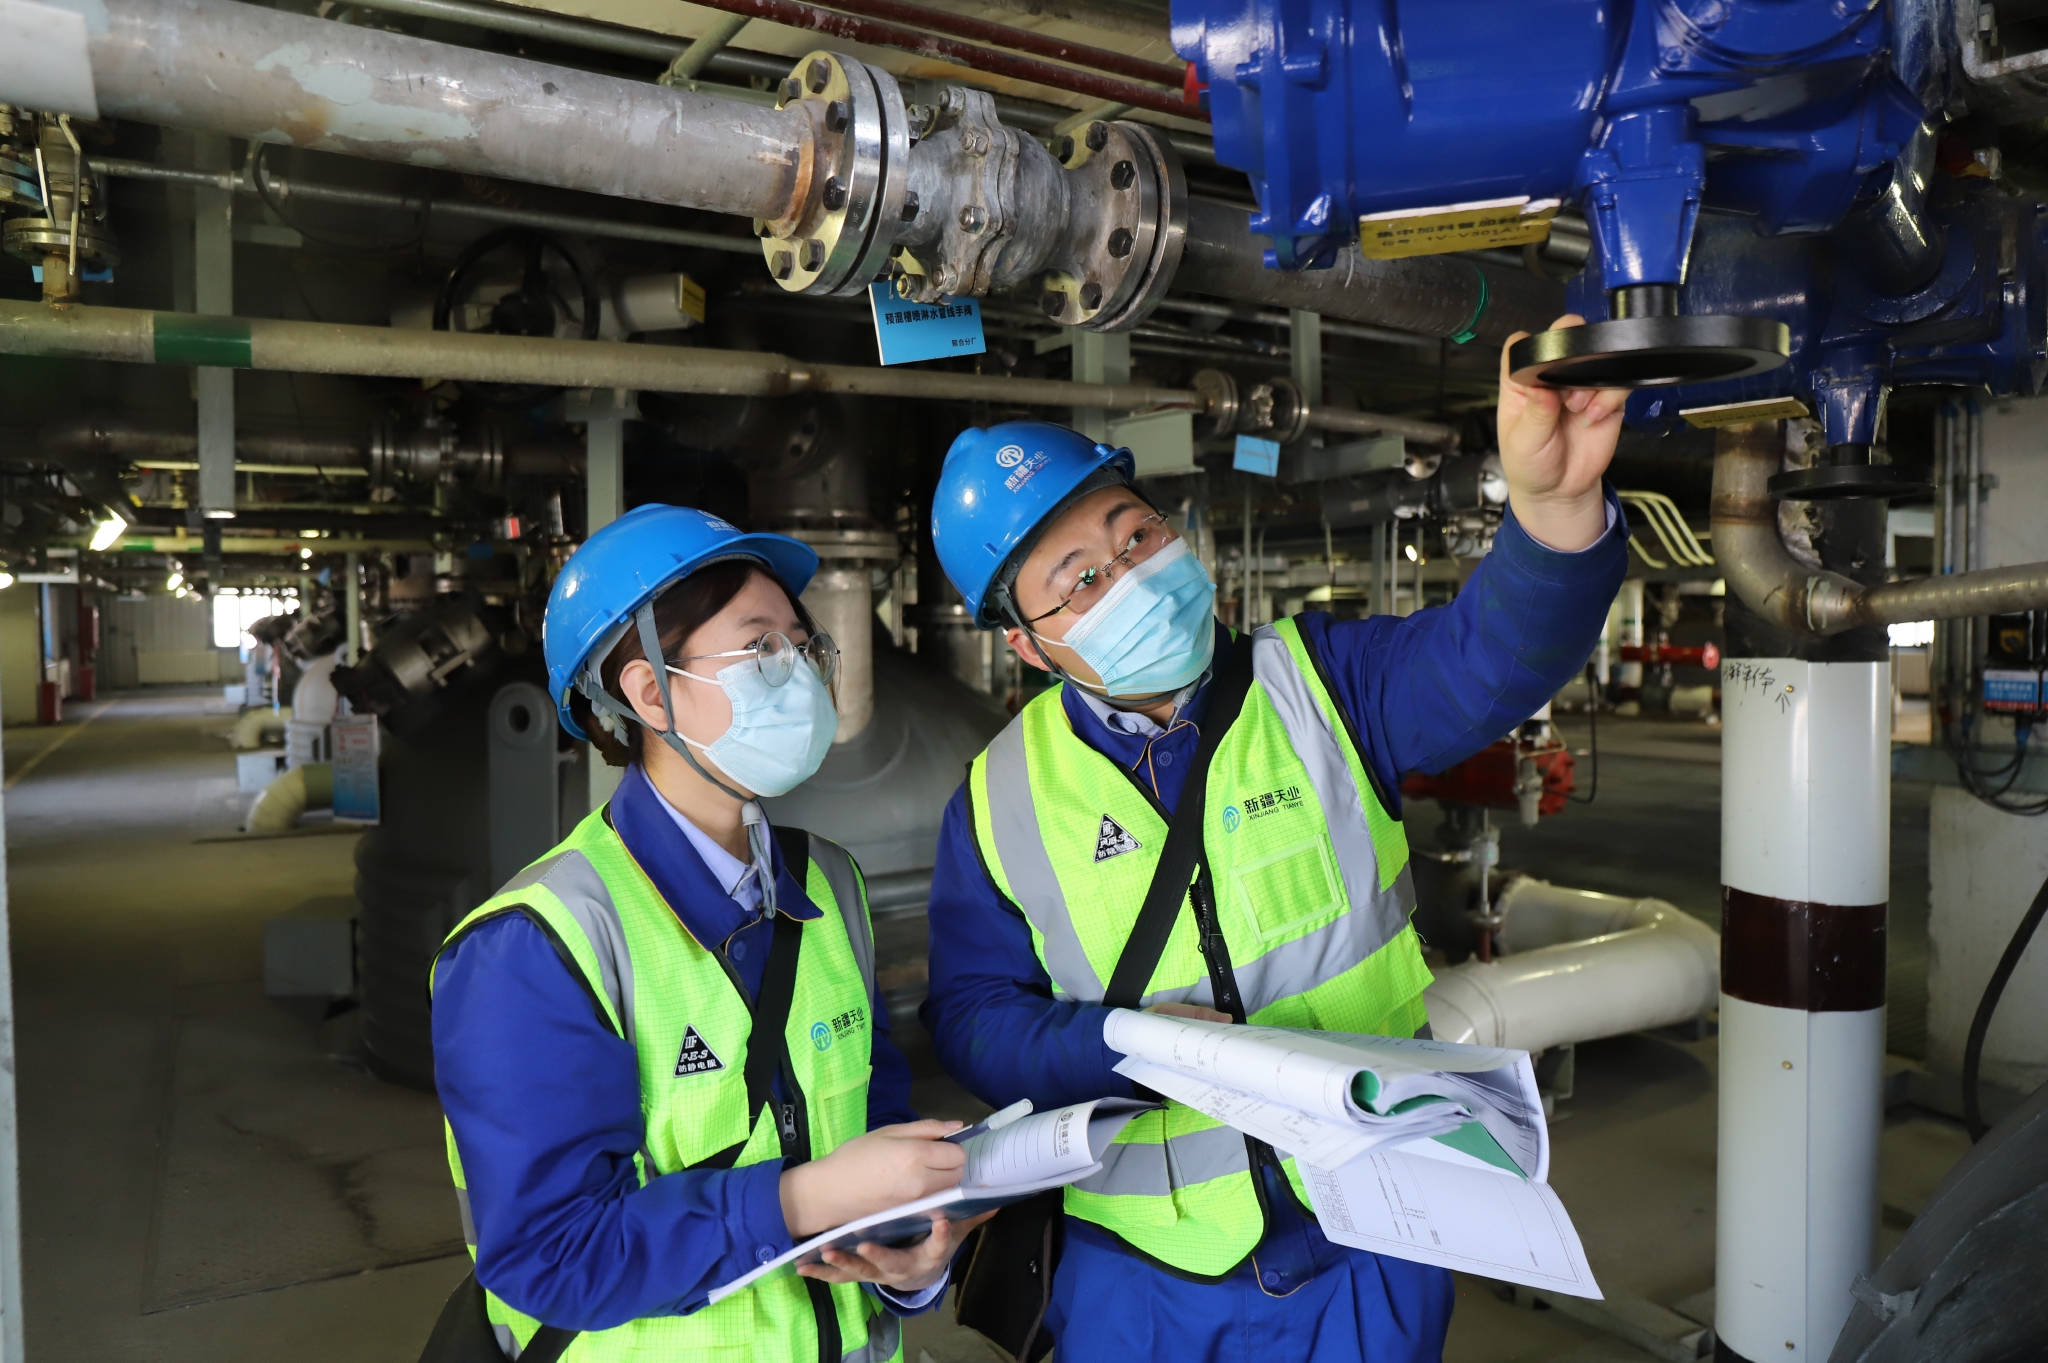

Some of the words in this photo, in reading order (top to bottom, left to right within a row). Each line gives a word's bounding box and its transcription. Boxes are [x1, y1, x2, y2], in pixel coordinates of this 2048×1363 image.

[884, 304, 973, 325] 预混槽喷淋水管线手阀
[1003, 450, 1048, 491] 新疆天业
[1243, 785, 1302, 814] 新疆天业
[1248, 806, 1280, 821] XINJIANG
[1282, 801, 1304, 811] TIANYE
[831, 1006, 865, 1034] 新疆天业
[678, 1059, 717, 1073] 防静电服
